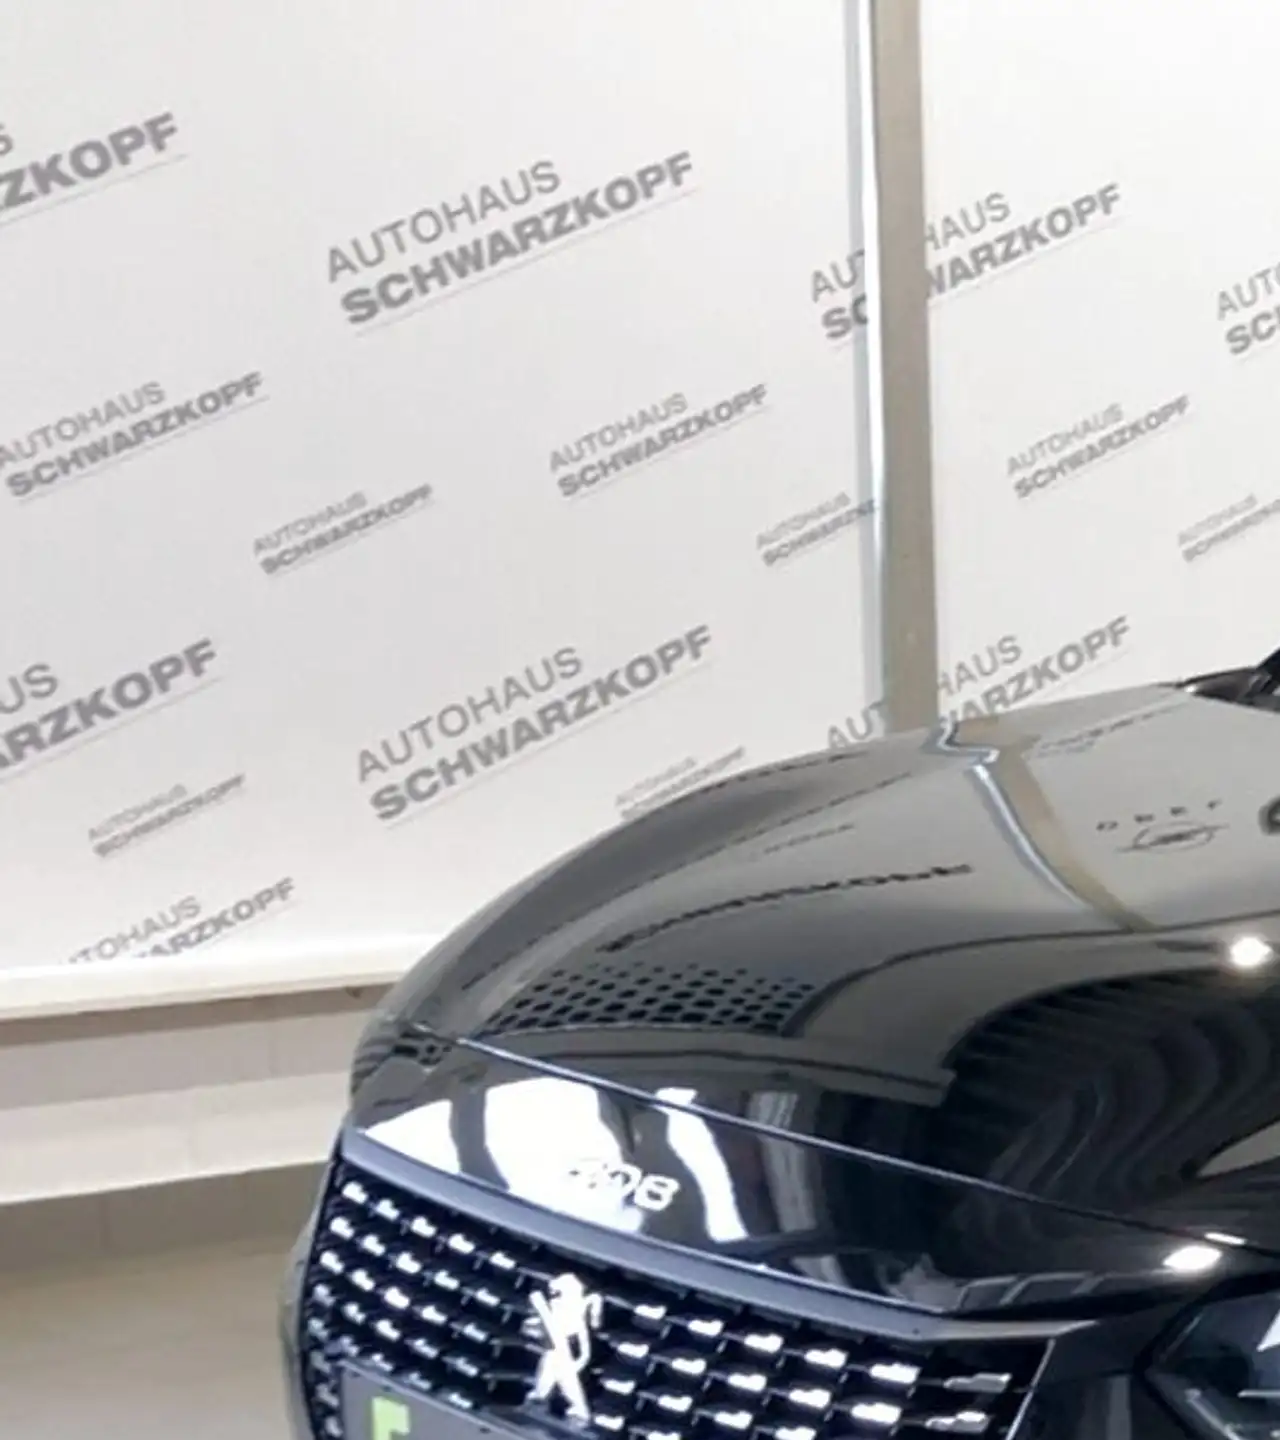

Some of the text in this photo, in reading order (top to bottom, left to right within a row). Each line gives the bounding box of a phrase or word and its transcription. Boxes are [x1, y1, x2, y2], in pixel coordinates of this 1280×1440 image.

[327, 160, 561, 283] AUTOHAUS
[340, 150, 693, 325] SCHWARZKOPF
[0, 381, 165, 470] AUTOHAUS
[5, 371, 264, 497] SCHWARZKOPF
[548, 392, 689, 473] AUTOHAUS
[556, 384, 768, 498] SCHWARZKOPF
[357, 646, 584, 783] AUTOHAUS
[370, 624, 712, 820] SCHWARZKOPF
